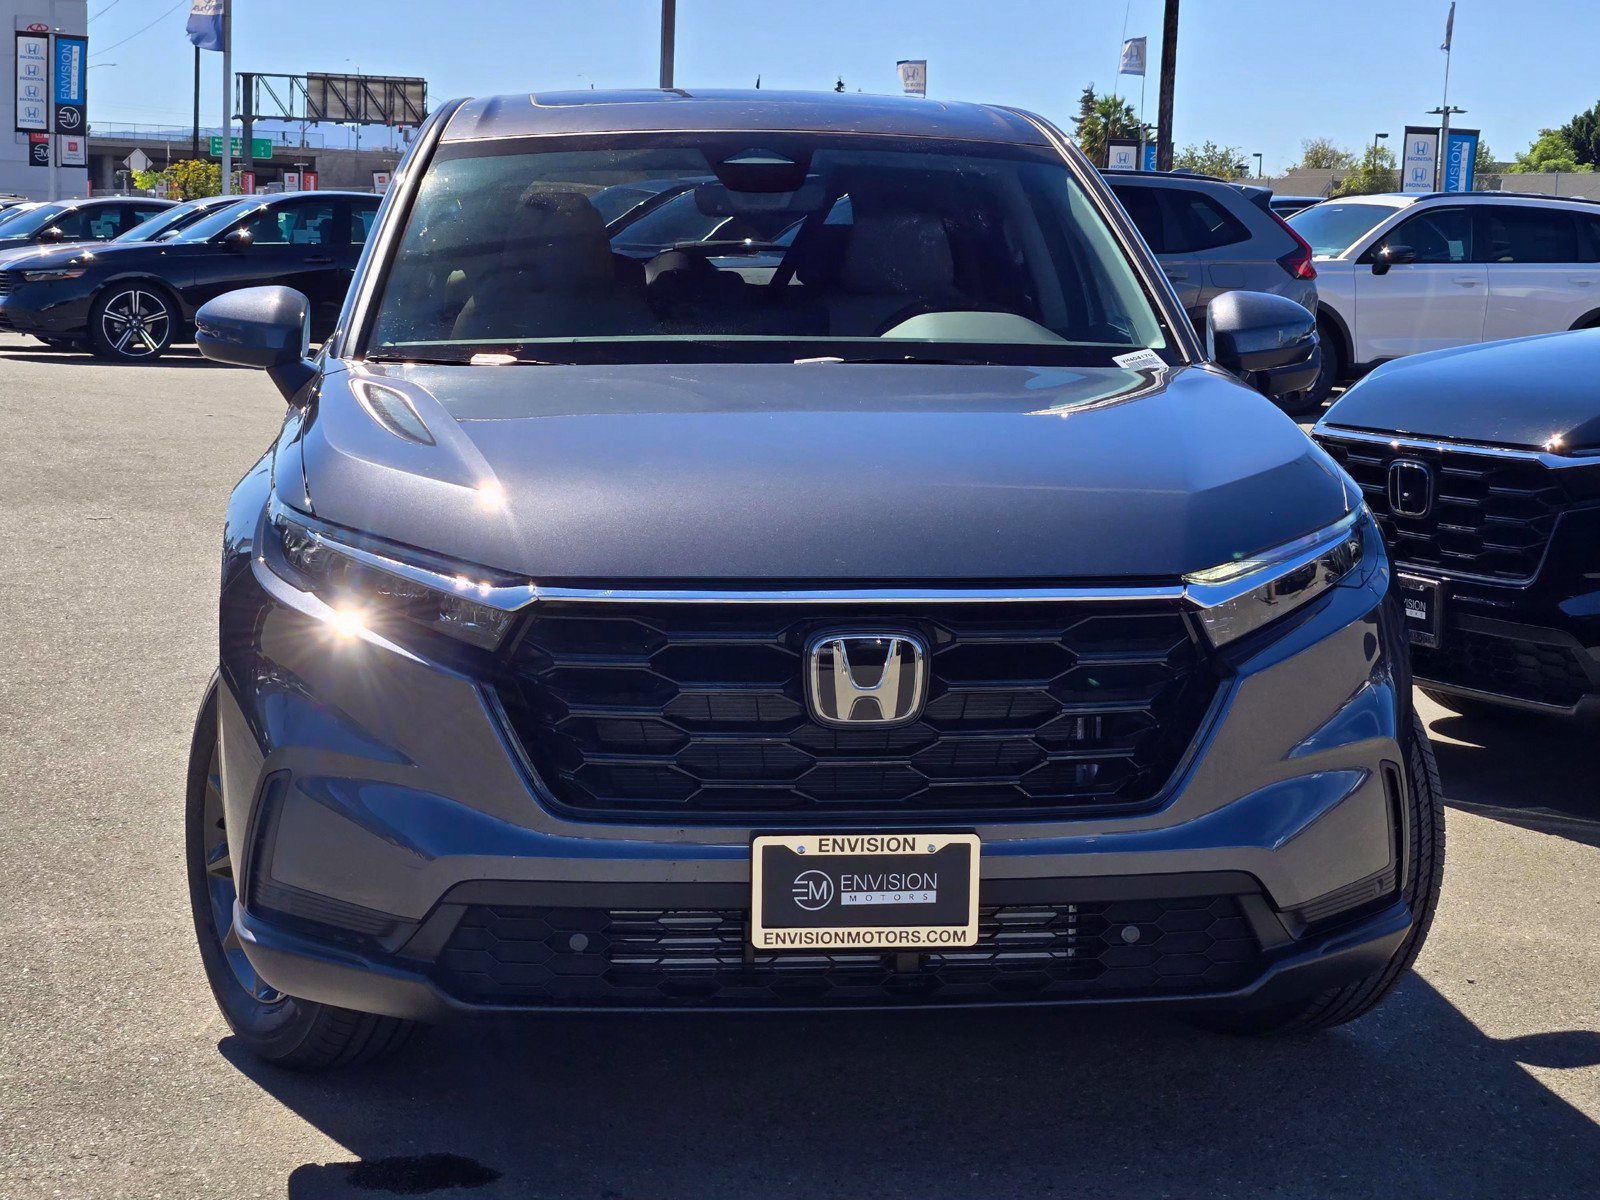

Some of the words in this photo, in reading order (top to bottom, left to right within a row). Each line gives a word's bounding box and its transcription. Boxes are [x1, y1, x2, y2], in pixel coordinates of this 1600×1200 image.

[60, 44, 72, 100] ENVISION
[818, 837, 916, 852] ENVISION
[841, 872, 938, 891] ENVISION
[849, 894, 928, 902] MOTORS
[763, 930, 967, 945] ENVISIONMOTORS.COM
